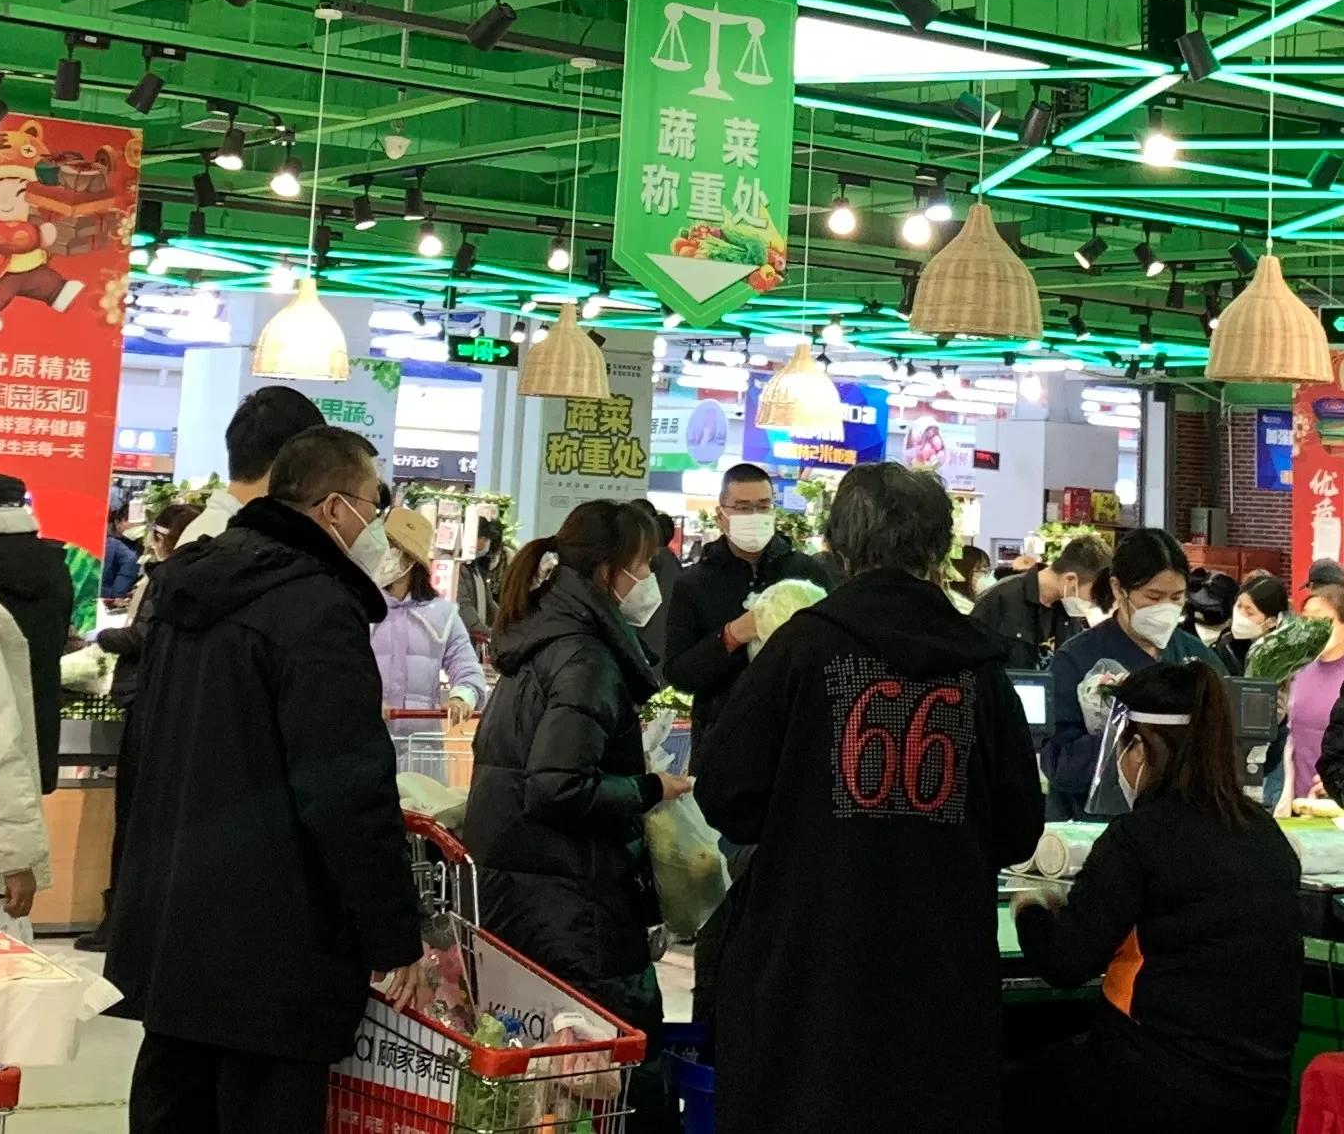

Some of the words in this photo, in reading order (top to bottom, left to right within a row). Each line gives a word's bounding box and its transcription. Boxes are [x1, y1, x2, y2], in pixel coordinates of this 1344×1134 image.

[657, 106, 761, 170] 蔬菜
[640, 163, 769, 230] 称重处
[310, 397, 367, 424] 果蔬
[564, 392, 633, 436] 蔬菜
[545, 432, 647, 479] 称重处
[840, 679, 962, 813] 66
